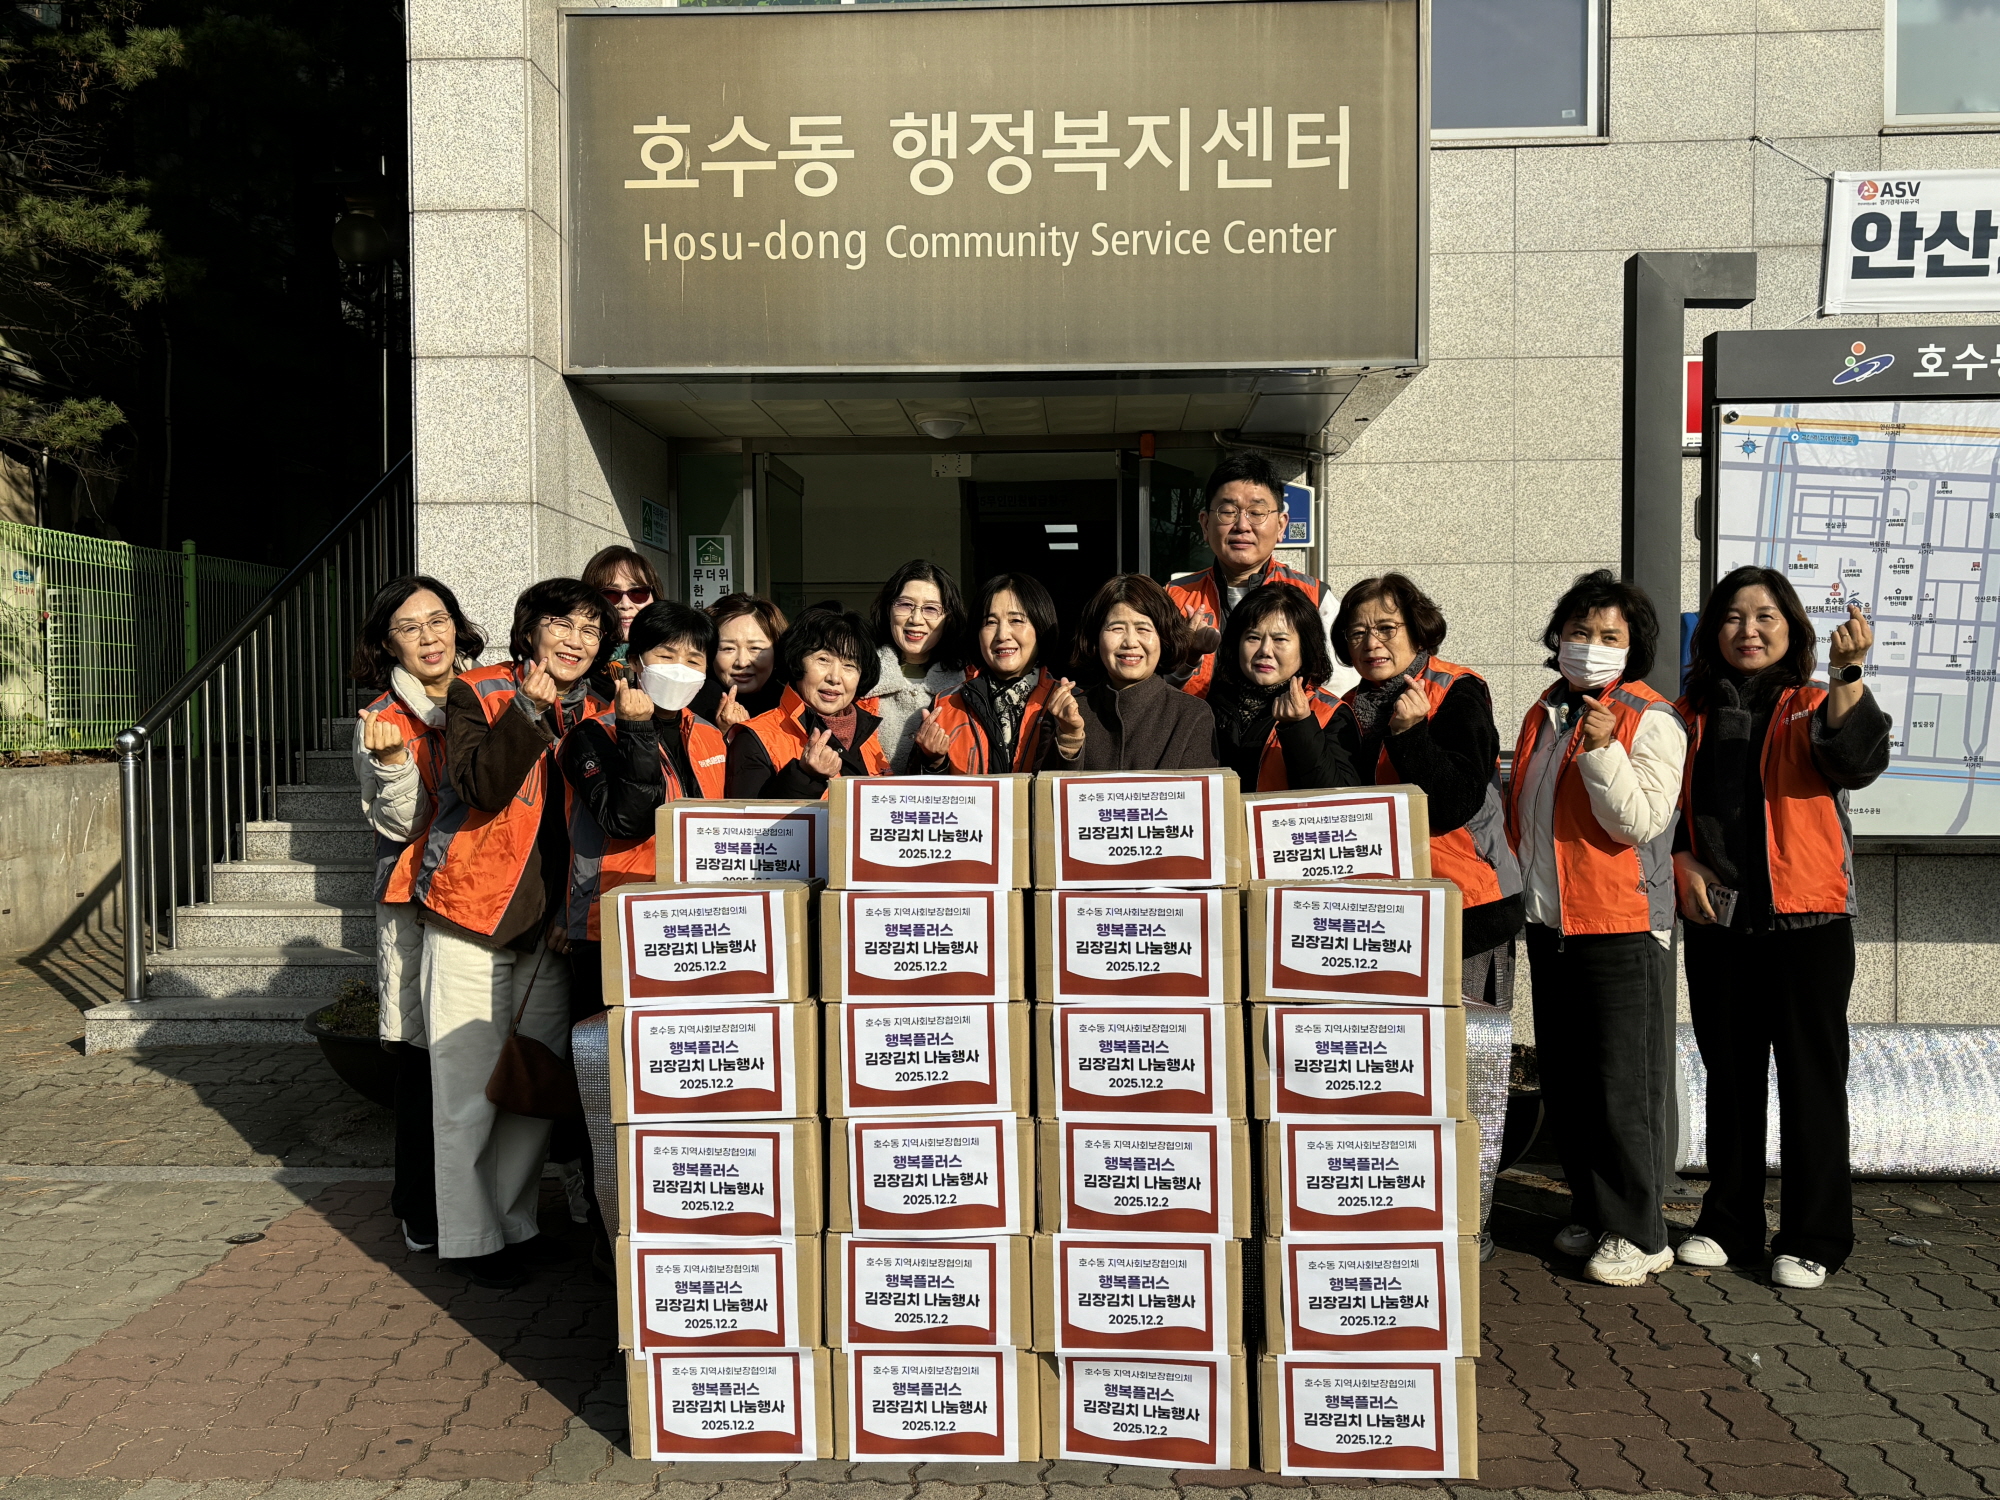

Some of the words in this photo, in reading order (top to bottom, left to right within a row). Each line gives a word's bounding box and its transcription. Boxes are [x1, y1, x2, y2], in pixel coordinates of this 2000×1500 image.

[624, 115, 855, 198] 호수동
[889, 105, 1351, 196] 행정복지센터
[1879, 181, 1921, 198] ASV
[642, 220, 868, 270] Hosu-dong
[886, 222, 1080, 268] Community
[1091, 219, 1211, 257] Service
[1223, 219, 1337, 256] Center
[1850, 209, 2000, 280] 안산
[1913, 343, 2000, 381] 호수
[693, 568, 729, 581] 무더위
[1824, 597, 1845, 605] 호수동
[1805, 605, 1845, 613] 행정복지센터
[871, 794, 897, 804] 호수동
[899, 795, 976, 805] 지역사회보장협의체
[1078, 792, 1105, 802] 호수동
[1107, 791, 1186, 802] 지역사회보장협의체
[889, 810, 959, 826] 행복플러스
[1097, 807, 1169, 823] 행복플러스
[1271, 817, 1297, 828] 호수동
[1298, 812, 1373, 826] 지역사회보장협의체
[696, 827, 720, 836] 호수동
[722, 827, 794, 837] 지역사회보장협의체
[869, 828, 924, 843] 김장김치
[928, 828, 984, 844] 나눔행사
[1077, 825, 1134, 841] 김장김치
[1137, 824, 1195, 840] 나눔행사
[1290, 828, 1358, 846] 행복플러스
[713, 841, 778, 856] 행복플러스
[898, 848, 952, 860] 2025.12.2
[1107, 845, 1163, 857] 2025.12.2
[1272, 847, 1326, 864] 김장김치
[1328, 843, 1383, 860] 나눔행사
[695, 857, 746, 872] 김장김치
[749, 858, 801, 874] 나눔행사
[1301, 864, 1354, 878] 2025.12.2
[643, 909, 669, 919] 호수동
[670, 905, 747, 918] 지역사회보장협의체
[1076, 907, 1103, 917] 호수동
[1105, 907, 1184, 917] 지역사회보장협의체
[1293, 900, 1321, 911] 호수동
[1322, 901, 1405, 914] 지역사회보장협의체
[662, 922, 732, 939] 행복플러스
[1095, 922, 1167, 938] 행복플러스
[1312, 916, 1386, 934] 행복플러스
[643, 941, 698, 958] 김장김치
[701, 938, 757, 955] 나눔행사
[1075, 940, 1132, 955] 김장김치
[1135, 940, 1193, 956] 나눔행사
[1290, 934, 1349, 951] 김장김치
[1352, 937, 1413, 954] 나눔행사
[673, 960, 727, 973] 2025.12.2
[1105, 960, 1161, 972] 2025.12.2
[1321, 956, 1378, 970] 2025.12.2
[650, 1025, 676, 1035] 호수동
[678, 1023, 756, 1035] 지역사회보장협의체
[865, 1017, 891, 1028] 호수동
[893, 1015, 971, 1027] 지역사회보장협의체
[1294, 1024, 1322, 1034] 호수동
[1324, 1024, 1406, 1034] 지역사회보장협의체
[884, 1031, 955, 1048] 행복플러스
[669, 1039, 740, 1056] 행복플러스
[1314, 1040, 1388, 1056] 행복플러스
[649, 1058, 705, 1074] 김장김치
[708, 1056, 765, 1072] 나눔행사
[864, 1050, 920, 1067] 김장김치
[923, 1049, 980, 1065] 나눔행사
[1293, 1058, 1352, 1074] 김장김치
[1355, 1058, 1415, 1074] 나눔행사
[679, 1077, 734, 1090] 2025.12.2
[894, 1070, 950, 1083] 2025.12.2
[1325, 1079, 1382, 1091] 2025.12.2
[653, 1146, 679, 1156] 호수동
[681, 1146, 757, 1157] 지역사회보장협의체
[1084, 1139, 1111, 1149] 호수동
[1113, 1140, 1193, 1151] 지역사회보장협의체
[1306, 1140, 1334, 1151] 호수동
[1336, 1140, 1417, 1150] 지역사회보장협의체
[671, 1162, 740, 1178] 행복플러스
[1103, 1156, 1176, 1172] 행복플러스
[1326, 1157, 1400, 1172] 행복플러스
[652, 1179, 706, 1195] 김장김치
[709, 1181, 765, 1196] 나눔행사
[1083, 1173, 1140, 1190] 김장김치
[1143, 1175, 1202, 1191] 나눔행사
[1306, 1175, 1364, 1190] 김장김치
[1367, 1174, 1426, 1190] 나눔행사
[681, 1200, 735, 1212] 2025.12.2
[1113, 1195, 1170, 1208] 2025.12.2
[1337, 1195, 1394, 1207] 2025.12.2
[866, 1257, 892, 1267] 호수동
[894, 1257, 973, 1268] 지역사회보장협의체
[1308, 1260, 1336, 1271] 호수동
[1338, 1259, 1420, 1270] 지역사회보장협의체
[885, 1273, 955, 1289] 행복플러스
[1328, 1276, 1403, 1292] 행복플러스
[864, 1291, 920, 1307] 김장김치
[924, 1292, 981, 1308] 나눔행사
[1308, 1295, 1367, 1310] 김장김치
[1370, 1294, 1430, 1310] 나눔행사
[894, 1312, 949, 1325] 2025.12.2
[1339, 1315, 1397, 1327] 2025.12.2
[672, 1366, 698, 1376] 호수동
[700, 1366, 777, 1376] 지역사회보장협의체
[1084, 1367, 1111, 1377] 호수동
[1113, 1369, 1193, 1383] 지역사회보장협의체
[691, 1382, 760, 1397] 행복플러스
[1304, 1378, 1332, 1388] 호수동
[1334, 1378, 1416, 1389] 지역사회보장협의체
[1103, 1382, 1175, 1402] 행복플러스
[671, 1399, 727, 1414] 김장김치
[730, 1399, 786, 1414] 나눔행사
[1324, 1394, 1399, 1410] 행복플러스
[1083, 1399, 1139, 1418] 김장김치
[1143, 1404, 1201, 1422] 나눔행사
[701, 1419, 755, 1431] 2025.12.2
[1303, 1412, 1362, 1428] 김장김치
[1366, 1413, 1426, 1429] 나눔행사
[1112, 1421, 1168, 1436] 2025.12.2
[1335, 1433, 1393, 1446] 2025.12.2
